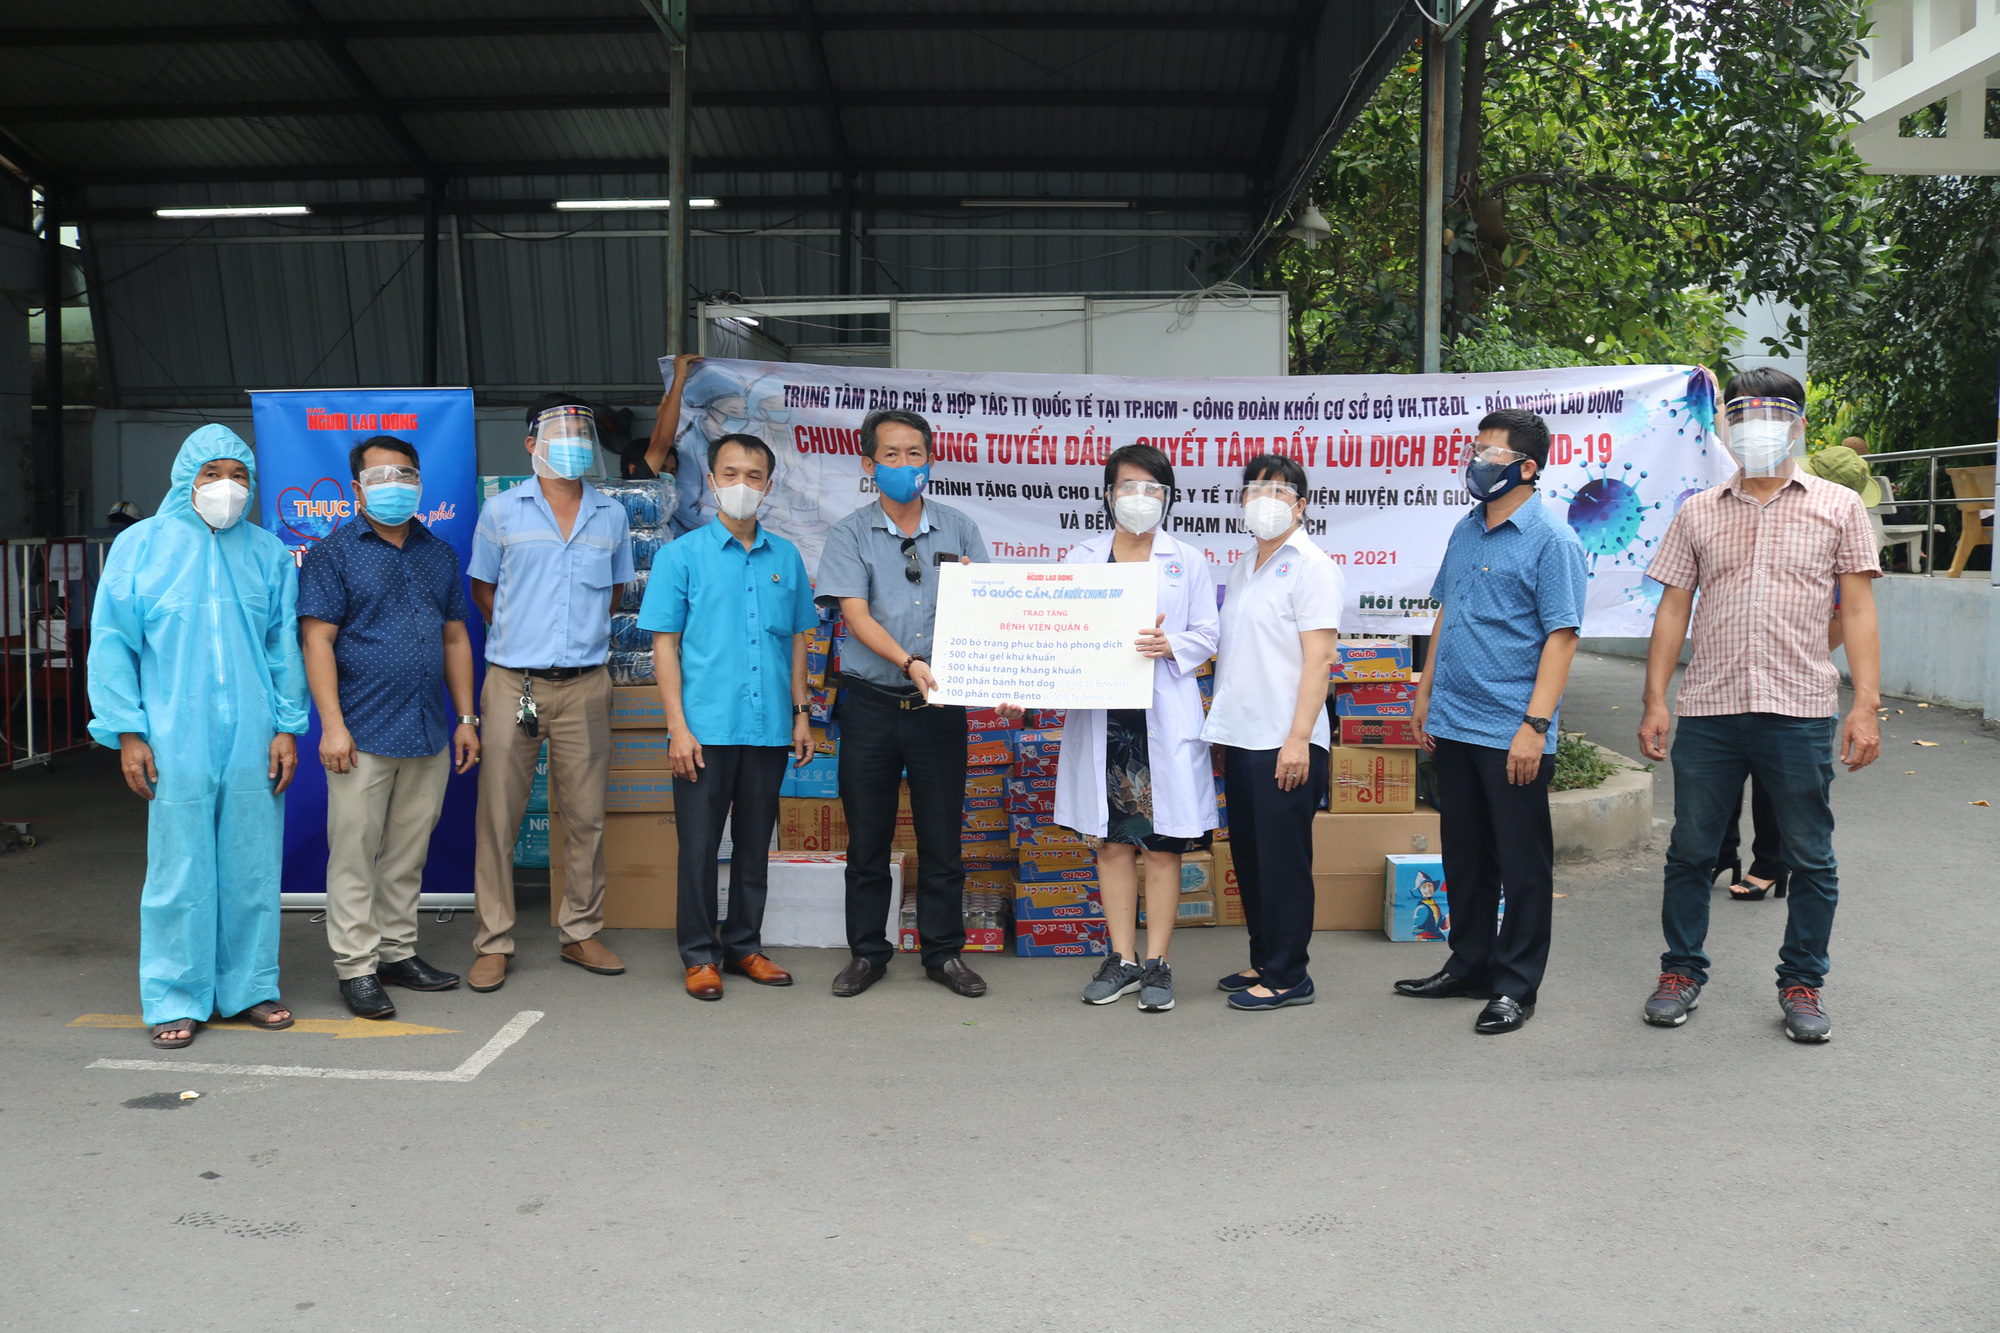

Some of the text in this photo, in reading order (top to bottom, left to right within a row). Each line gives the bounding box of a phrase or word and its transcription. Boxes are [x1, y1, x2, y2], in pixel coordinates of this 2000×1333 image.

[784, 383, 1624, 423] TRUNG TÂM BÁO CHÍ & HỢP TÁC TT QUỐC TẾ TẠI TP.HCM CÔNG ĐOÀN KHỐI CƠ SỞ BỘ VH,TT&DL BÁO NGƯỜI LAO ĐỘNG
[351, 414, 378, 431] LAO
[380, 412, 418, 431] ĐỘNG
[932, 425, 978, 463] ÙNG
[985, 425, 1057, 465] TUYẾN
[1064, 425, 1111, 466] ĐẦU
[1215, 431, 1264, 467] TÂM
[1326, 429, 1362, 468] LÙI
[1370, 434, 1424, 475] DỊCH
[928, 478, 972, 498] TRÌNH
[976, 480, 1017, 501] TẶNG
[1022, 480, 1054, 500] QUÀ
[1058, 485, 1089, 501] CHO
[1187, 488, 1197, 503] Y
[1202, 484, 1219, 504] TẾ
[1345, 485, 1399, 510] HUYỆN
[1404, 484, 1438, 506] CẦN
[294, 500, 350, 522] THỰC
[428, 502, 456, 527] phí
[1060, 509, 1080, 530] VÀ
[1085, 511, 1115, 533] BỆN
[1173, 516, 1220, 537] PHẠM
[992, 542, 1050, 558] Thành
[1354, 551, 1397, 565] 2021
[990, 586, 1023, 599] QUỐC
[1084, 588, 1109, 599] CHUNG
[1108, 588, 1124, 599] TAY
[1360, 595, 1393, 609] Môi
[1022, 609, 1045, 617] TRAO
[1000, 622, 1025, 632] BỆNH
[1028, 622, 1051, 633] VIỆN
[1054, 622, 1081, 633] QUẬN
[950, 638, 1123, 651] 200 bộ trang phục bảo hộ phòng dịch
[949, 651, 966, 659] 500
[968, 652, 987, 660] chai
[990, 652, 1004, 662] gel
[993, 665, 1018, 675] trang
[1020, 666, 1050, 676] kháng
[1353, 670, 1406, 679] Tôm Chua Cay
[947, 676, 965, 684] 200
[993, 678, 1016, 687] bánh
[1018, 678, 1035, 687] hot
[1037, 678, 1055, 689] dog
[946, 689, 963, 697] 100
[992, 691, 1011, 700] cơm
[1014, 692, 1042, 700] Bento
[1352, 725, 1393, 736] KOKOMI
[820, 741, 834, 752] Cay
[973, 787, 989, 795] Tôm
[976, 820, 991, 828] Tôm
[1043, 836, 1059, 844] Tôm
